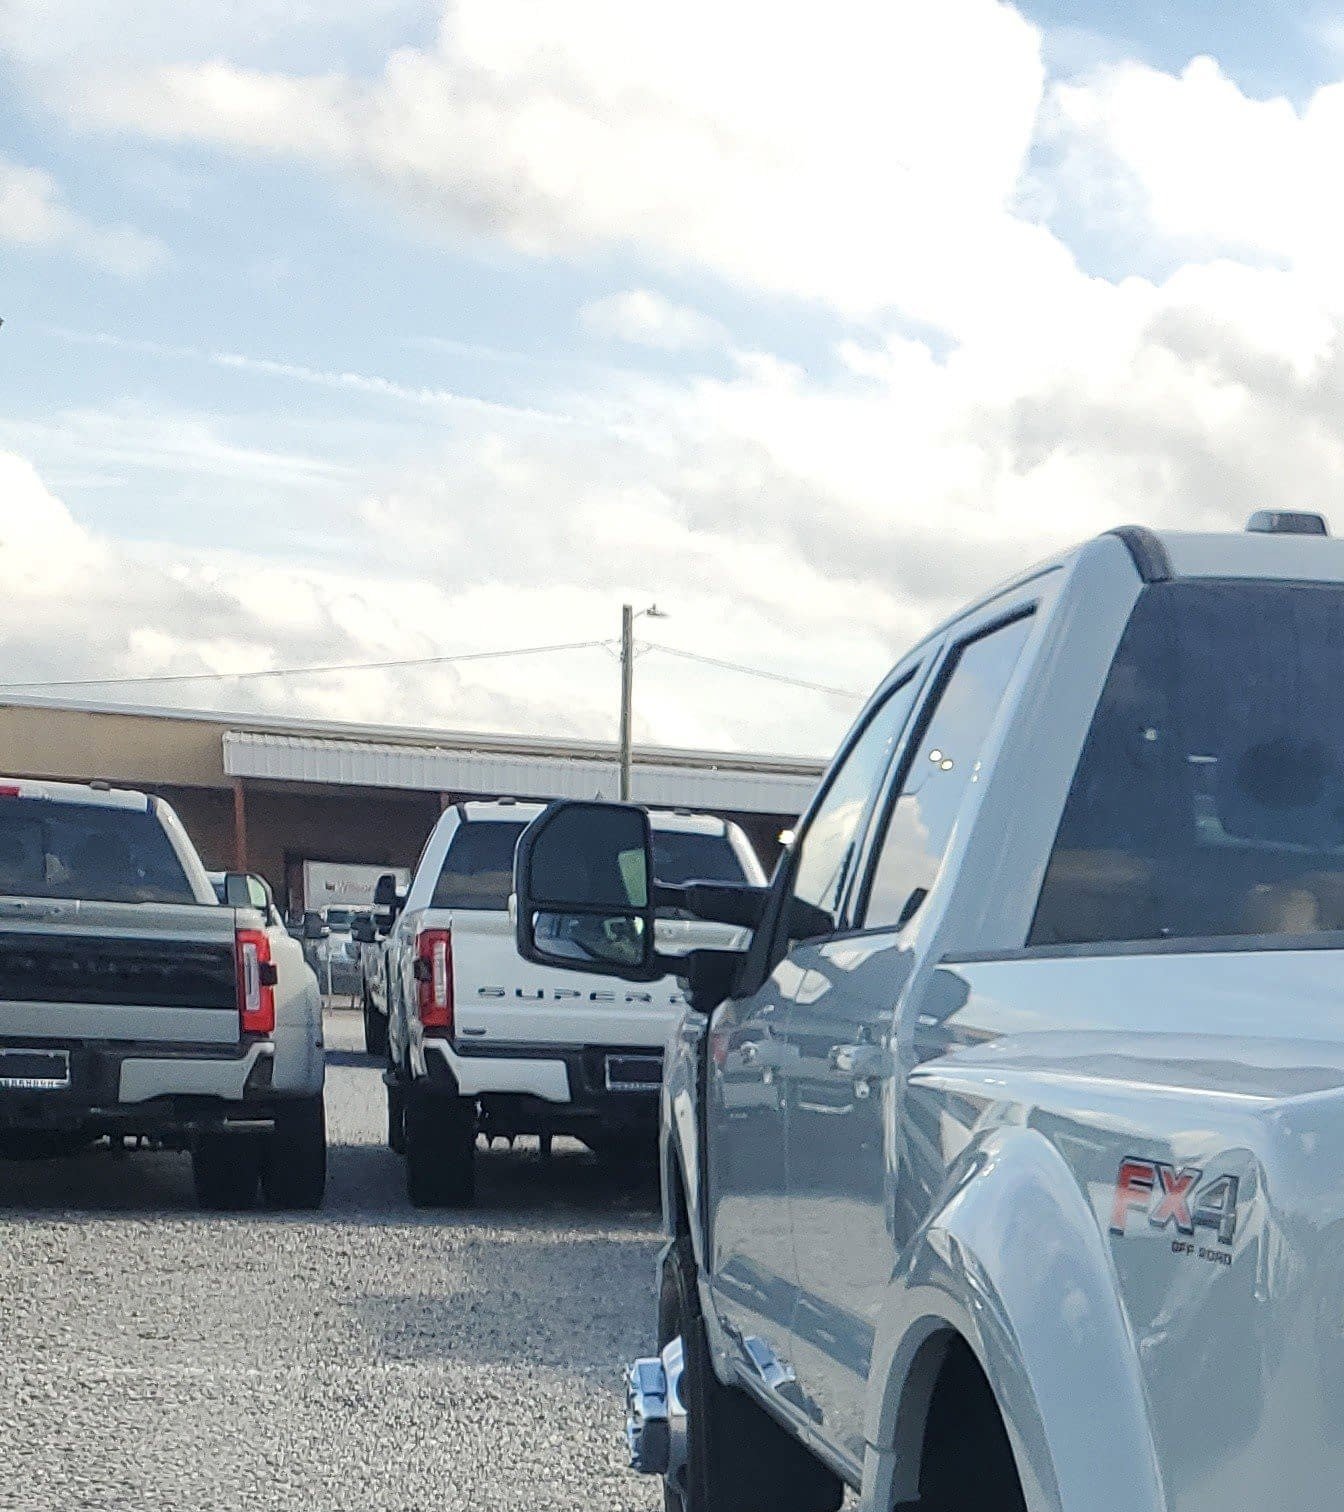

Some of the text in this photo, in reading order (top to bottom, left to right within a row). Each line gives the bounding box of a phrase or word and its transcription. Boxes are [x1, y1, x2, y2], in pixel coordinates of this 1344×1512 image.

[477, 986, 652, 1002] SUPER
[1109, 1155, 1239, 1245] FX4
[1199, 1247, 1232, 1266] ROAD
